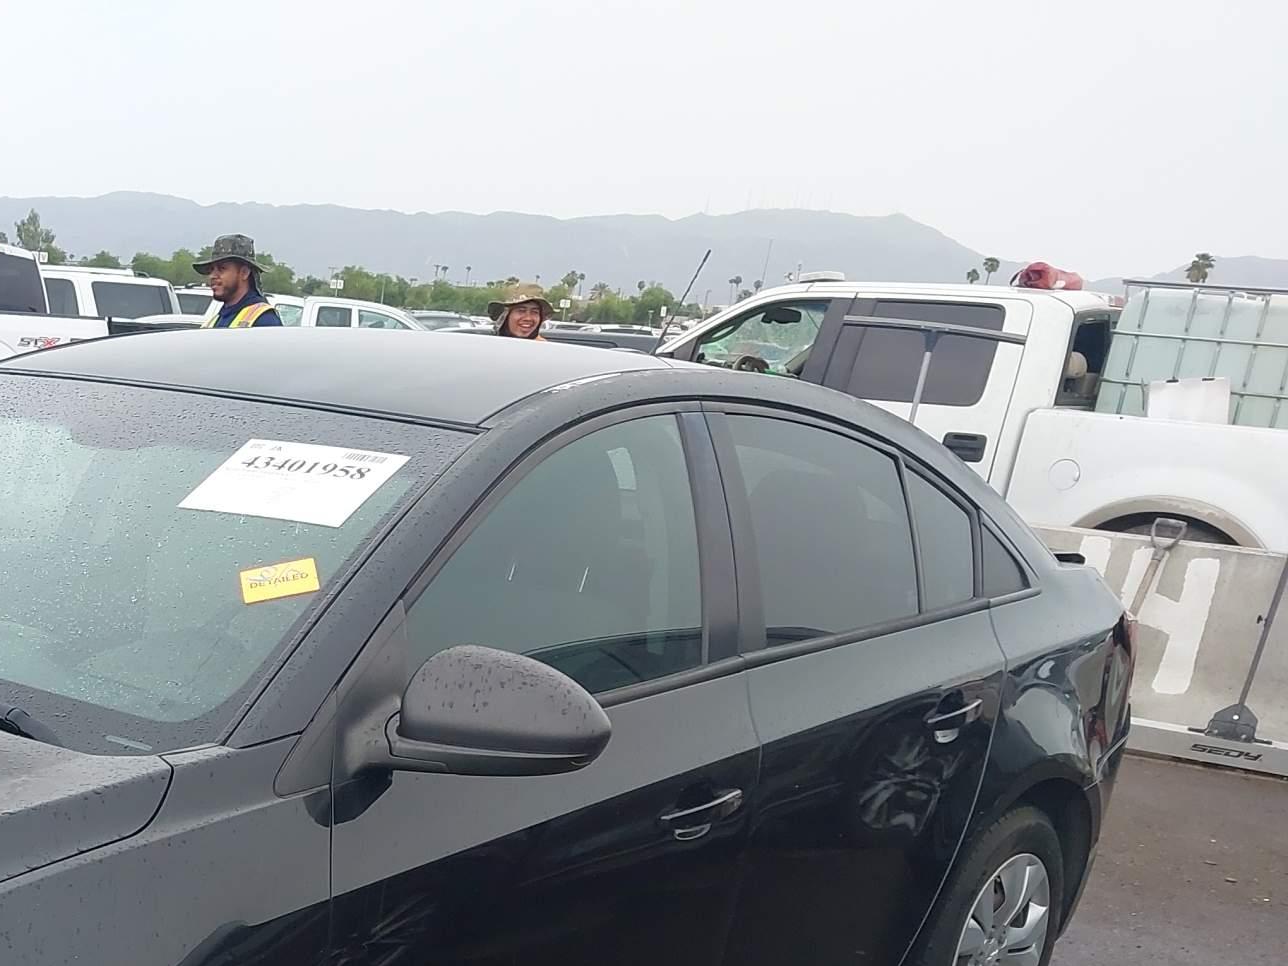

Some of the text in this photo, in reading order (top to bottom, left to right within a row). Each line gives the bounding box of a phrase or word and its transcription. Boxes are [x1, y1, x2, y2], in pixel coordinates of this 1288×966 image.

[16, 336, 61, 349] STX
[240, 455, 372, 481] 43401958
[249, 571, 310, 590] DETAILED
